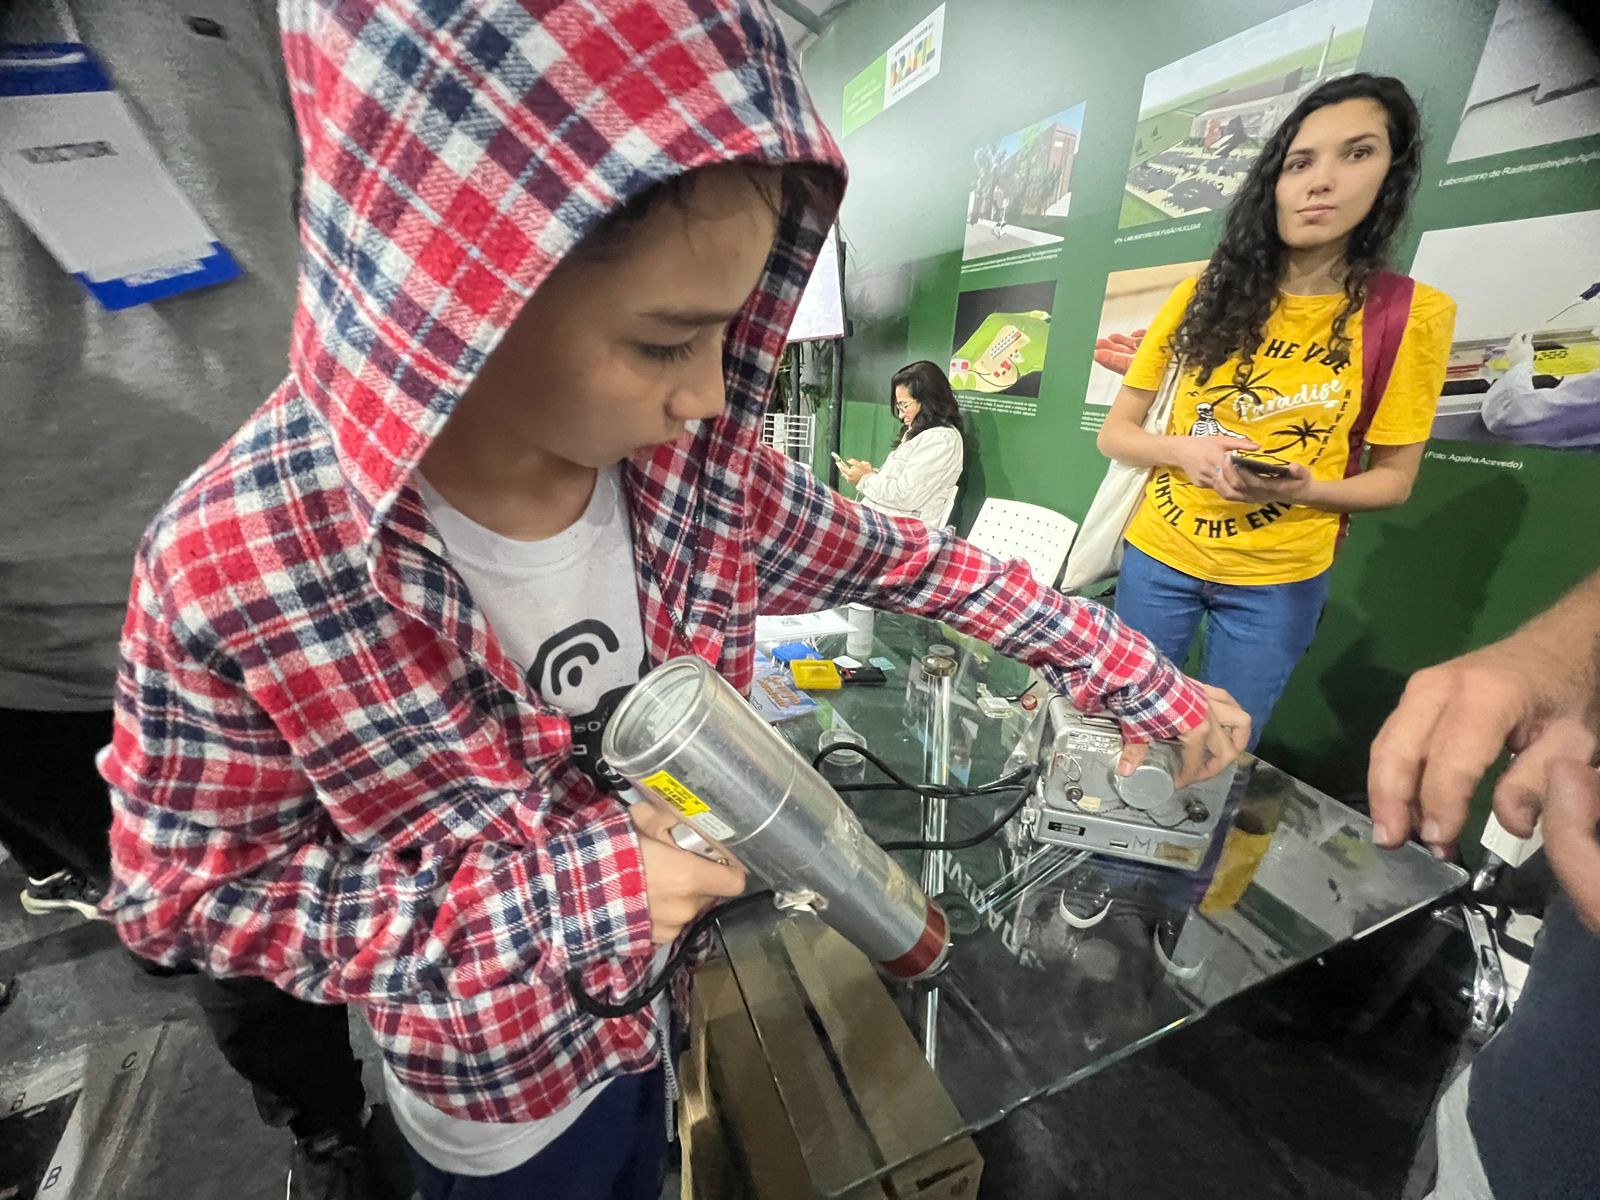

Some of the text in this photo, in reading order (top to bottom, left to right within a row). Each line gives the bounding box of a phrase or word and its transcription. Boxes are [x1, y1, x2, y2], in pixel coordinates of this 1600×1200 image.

[1233, 378, 1342, 422] Paradise
[1154, 472, 1185, 527] UNTIL
[1193, 517, 1239, 538] THE
[43, 1165, 63, 1191] B
